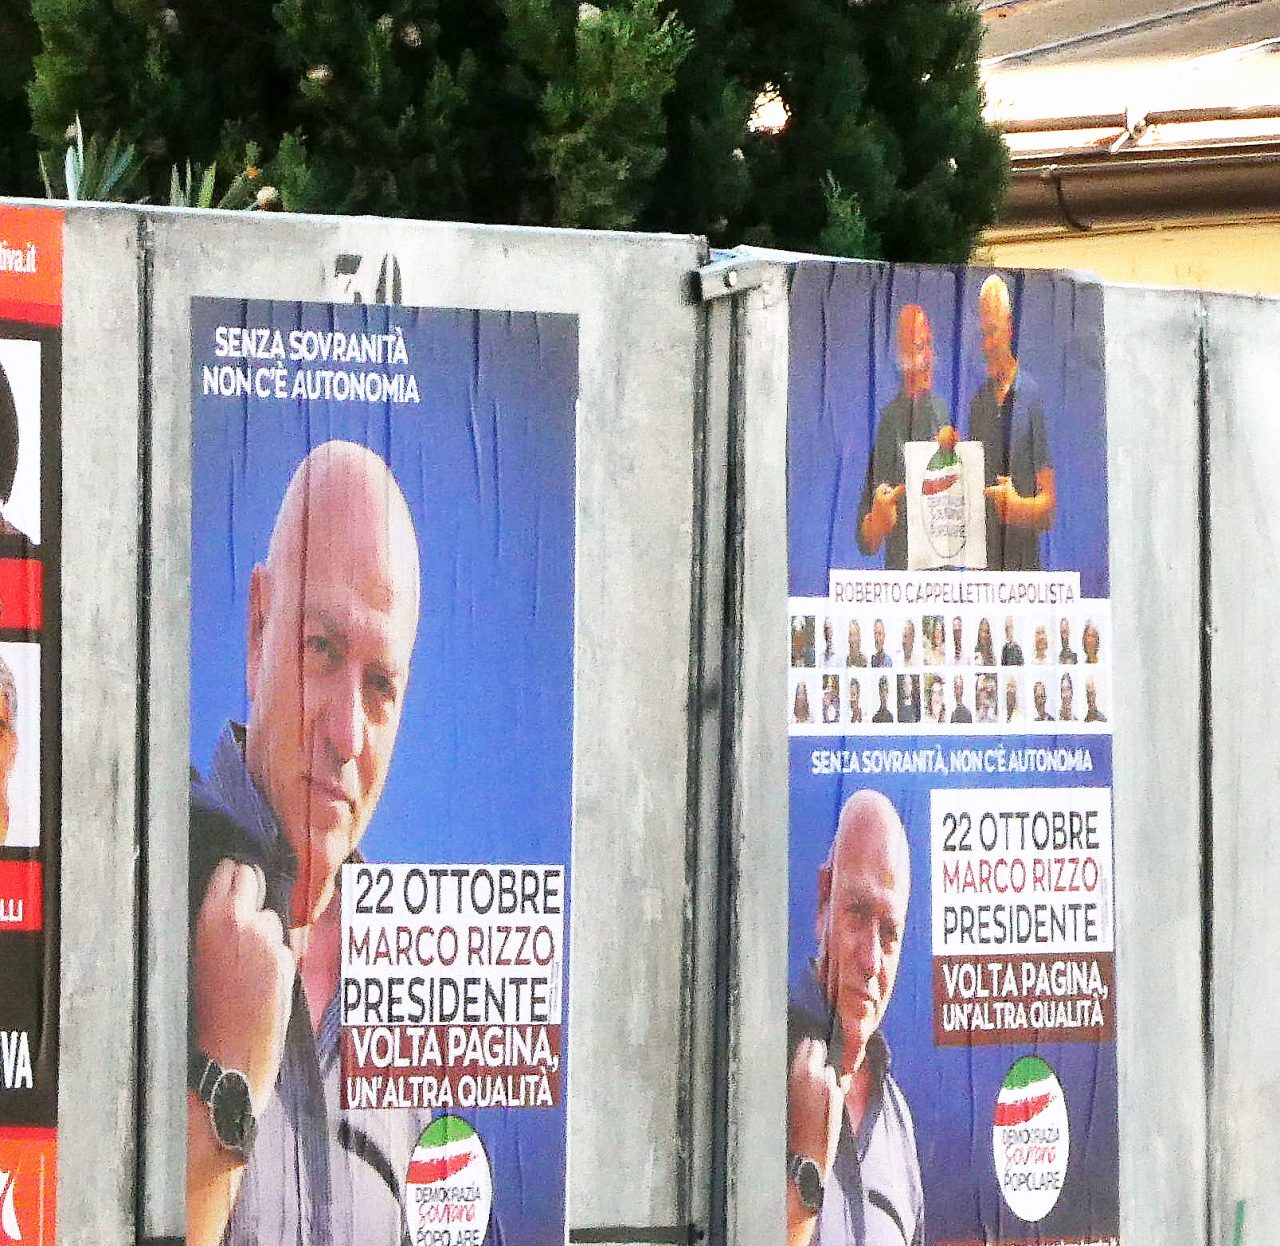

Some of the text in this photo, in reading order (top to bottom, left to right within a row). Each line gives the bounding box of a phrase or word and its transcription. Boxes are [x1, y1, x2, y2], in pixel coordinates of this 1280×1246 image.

[215, 325, 409, 365] SENZA SOVRANITÀ
[202, 360, 420, 404] NON C'È AUTONOMIA
[835, 582, 1074, 605] ROBERTO CAPPELLETTI CAPOLISTA
[810, 750, 860, 775] SENZA
[862, 744, 949, 776] SOVRANITÀ,
[950, 750, 984, 773] NON
[1008, 748, 1093, 773] AUTONOMIA
[943, 810, 1100, 852] 22 OTTOBRE
[355, 868, 561, 915] 22 OTTOBRE
[942, 856, 1099, 894] MARCO RIZZO
[943, 903, 1099, 944] PRESIDENTE
[348, 925, 555, 966] MARCO RIZZO
[343, 976, 549, 1024] PRESIDENTE
[942, 960, 1109, 1001] VOLTA PAGINA,
[942, 993, 1104, 1031] UN'ALTRA QUALITÀ
[351, 1026, 559, 1072] VOLTA PAGINA,
[346, 1066, 553, 1108] UN'ALTRA QUALITÀ
[415, 1186, 481, 1203] DEMOCRAZIA
